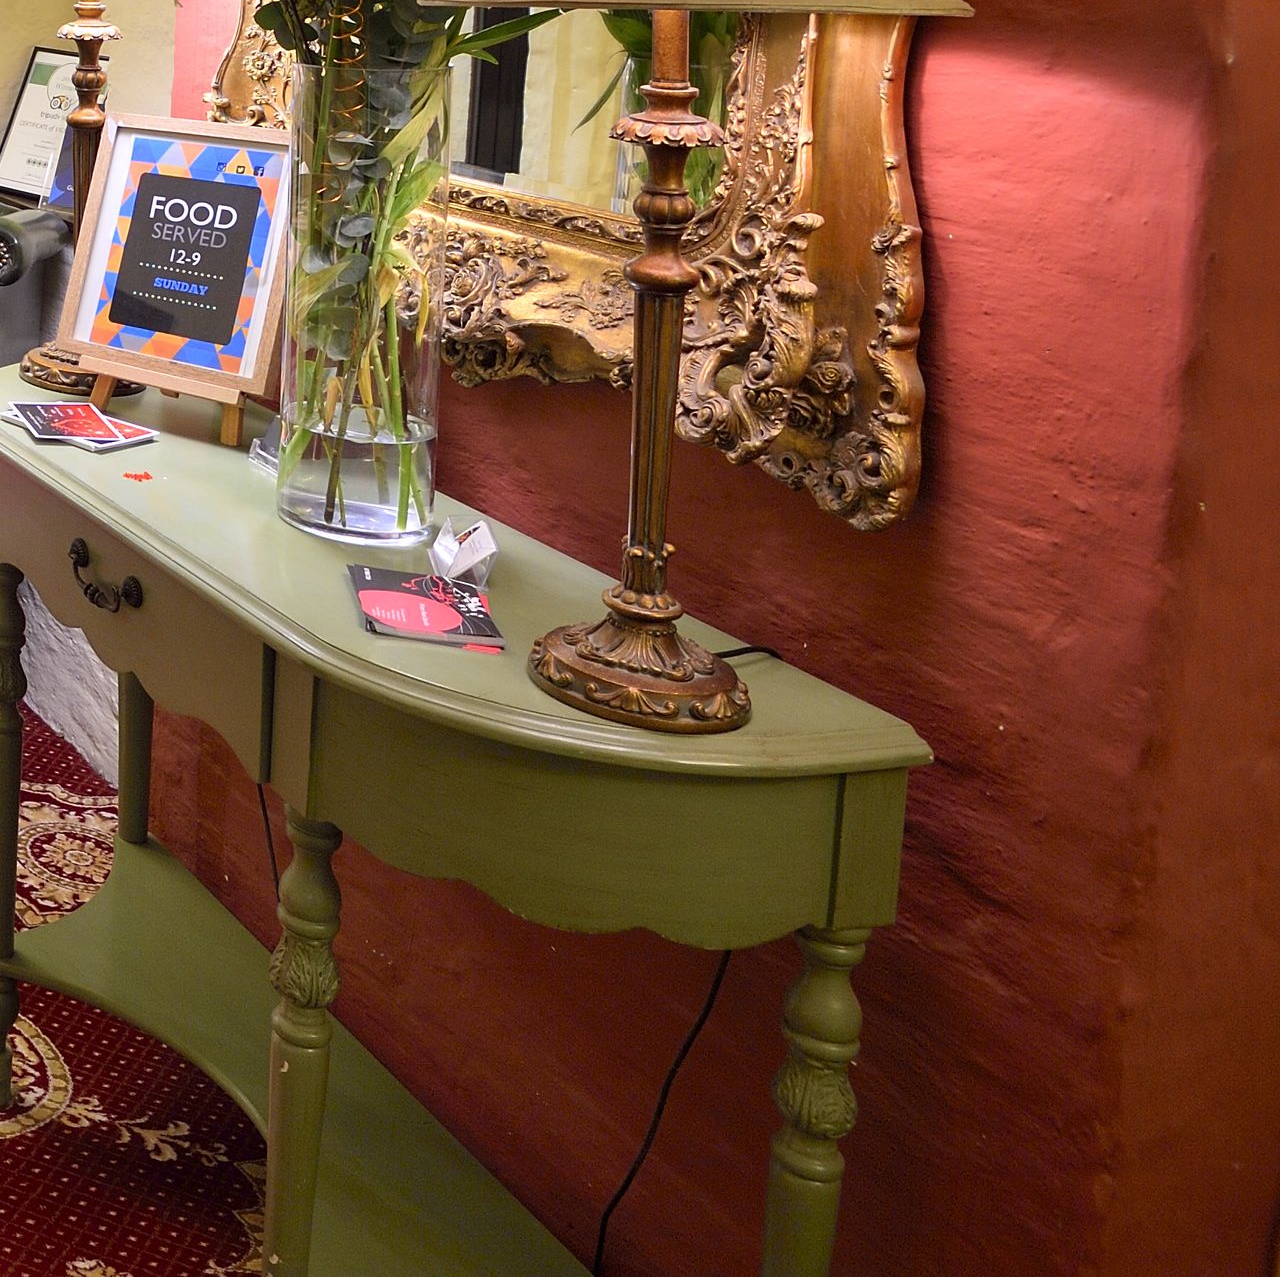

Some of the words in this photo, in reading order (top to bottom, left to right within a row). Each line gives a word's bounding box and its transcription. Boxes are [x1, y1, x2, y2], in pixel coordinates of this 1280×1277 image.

[149, 195, 238, 230] FOOD
[151, 222, 227, 249] SERVED
[169, 248, 202, 266] 12-9
[153, 277, 209, 296] SUNDAY
